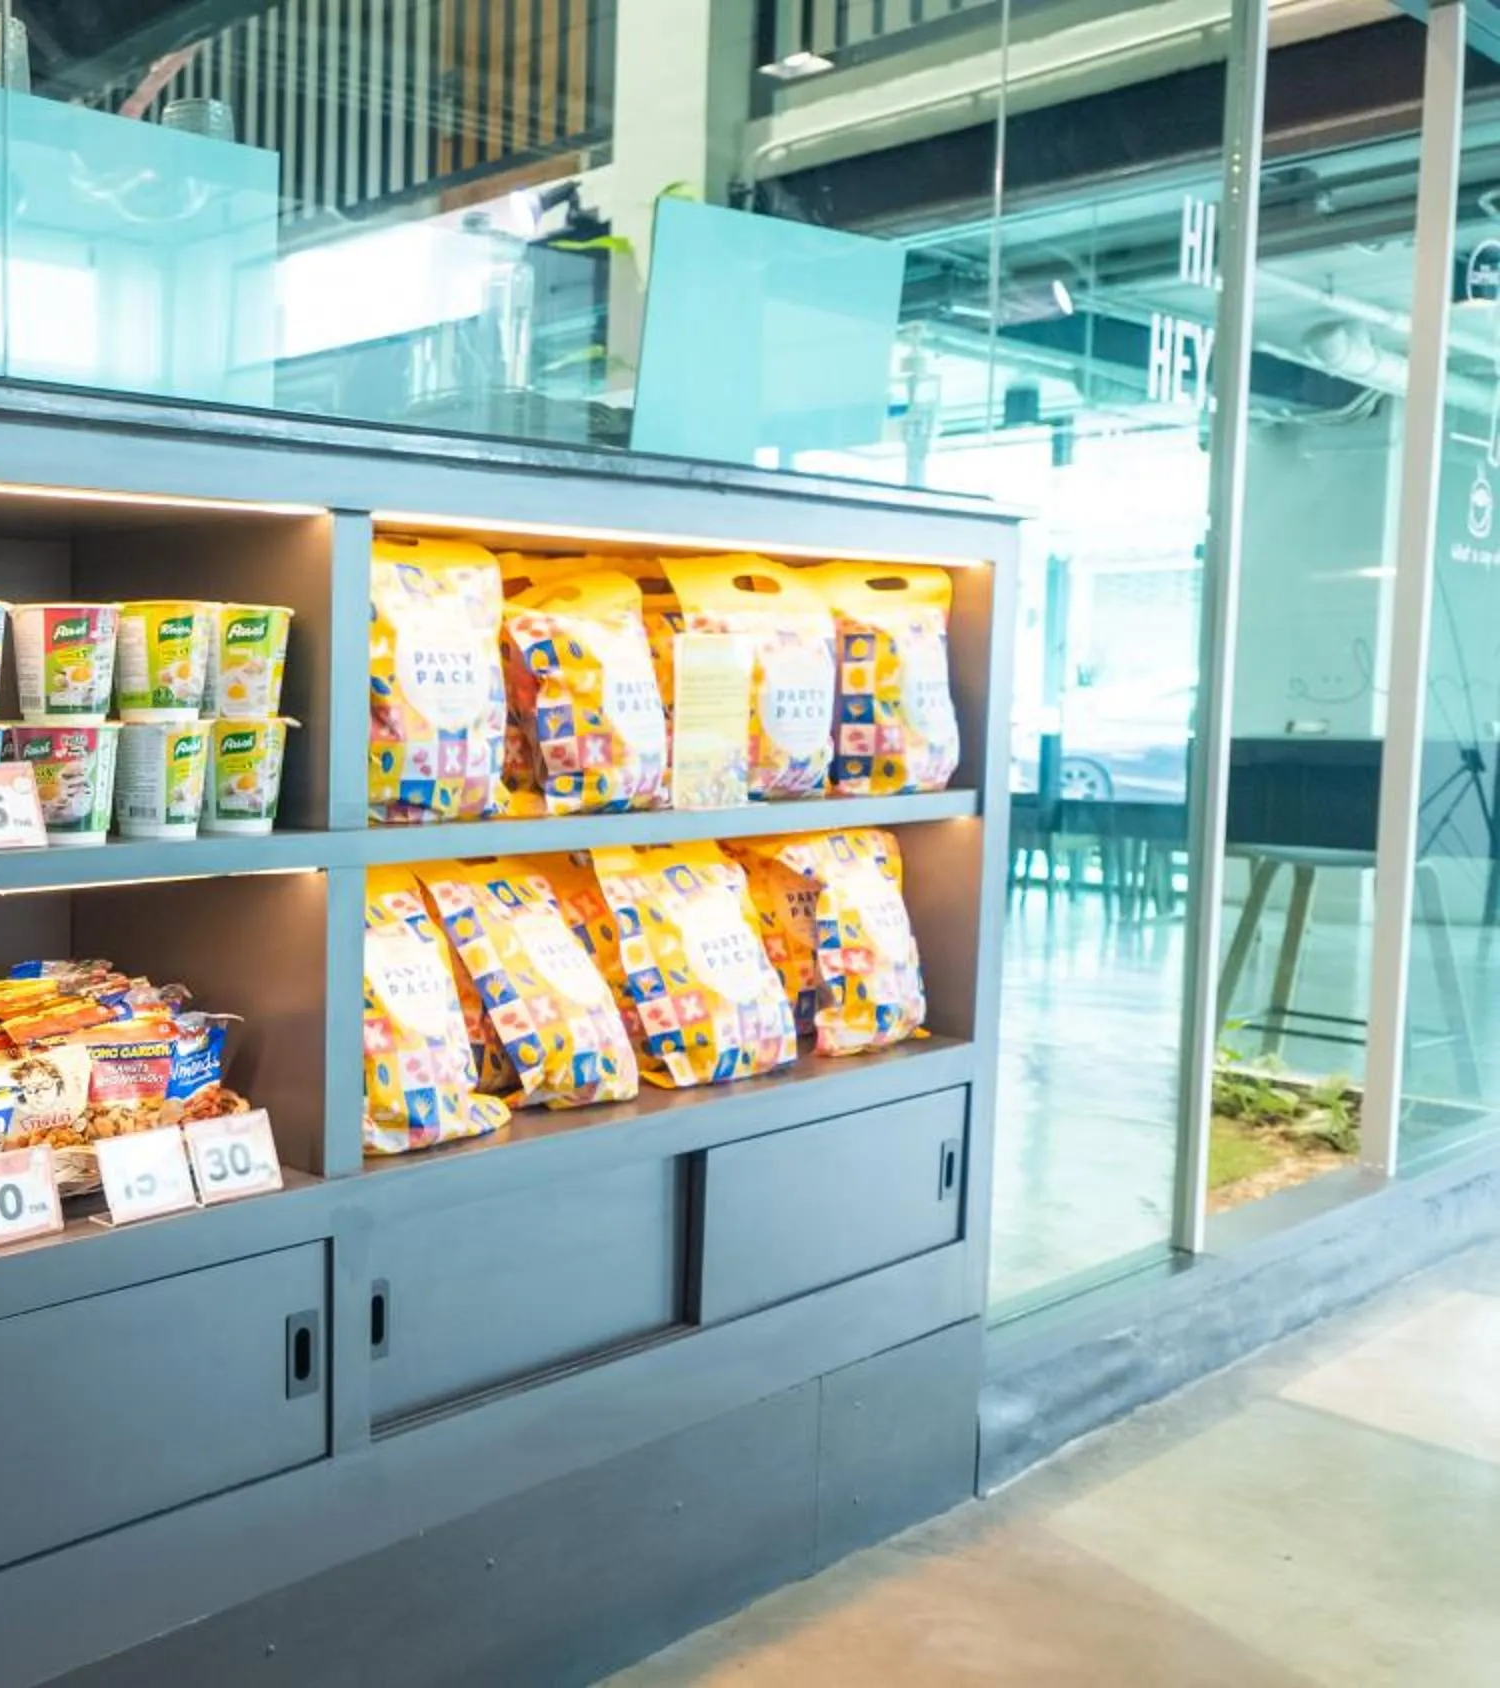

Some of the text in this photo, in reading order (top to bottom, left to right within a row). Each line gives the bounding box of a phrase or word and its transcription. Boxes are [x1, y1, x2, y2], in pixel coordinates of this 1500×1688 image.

[414, 651, 472, 666] PARTY
[415, 669, 476, 686] PACK
[205, 1142, 253, 1182] 30
